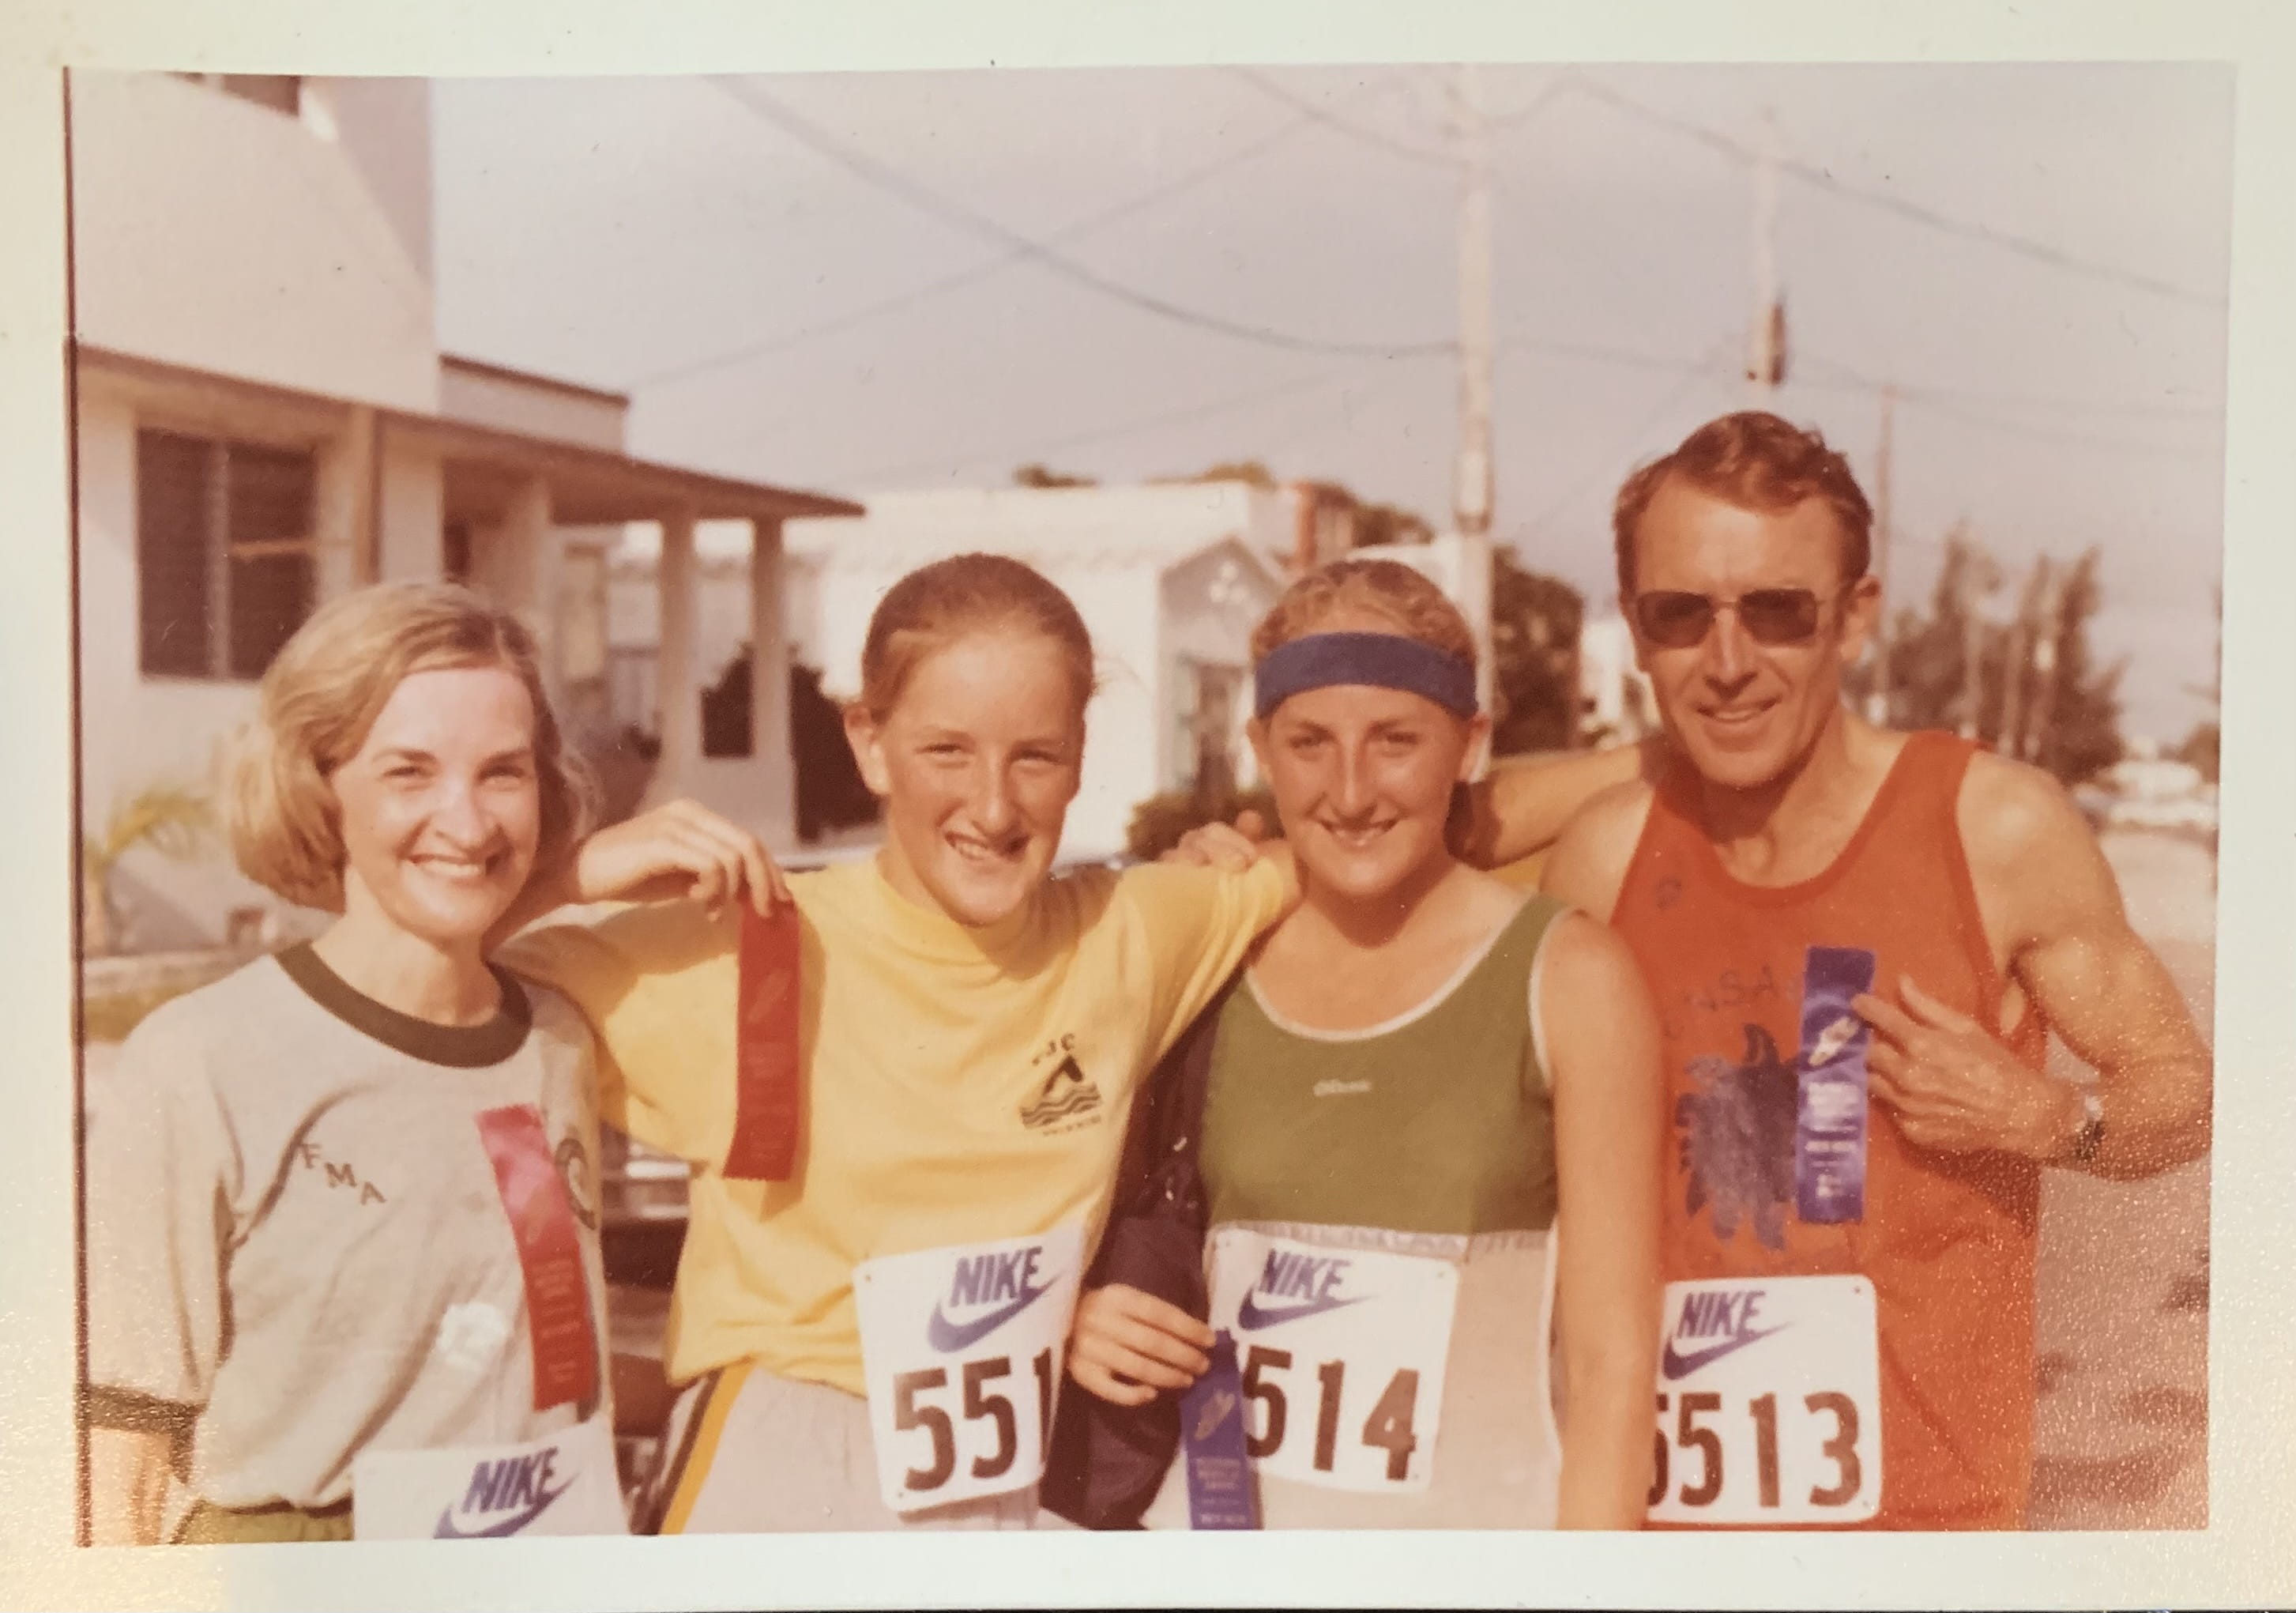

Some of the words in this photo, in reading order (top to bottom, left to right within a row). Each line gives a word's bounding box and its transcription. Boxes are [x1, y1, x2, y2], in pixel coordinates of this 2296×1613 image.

[302, 1142, 387, 1206] FMA
[950, 1246, 1041, 1307] NIKE
[1258, 1248, 1353, 1304] NIKE
[1677, 1291, 1767, 1340] NIKE
[1242, 1345, 1420, 1482] 514
[461, 1445, 559, 1513] NIKE
